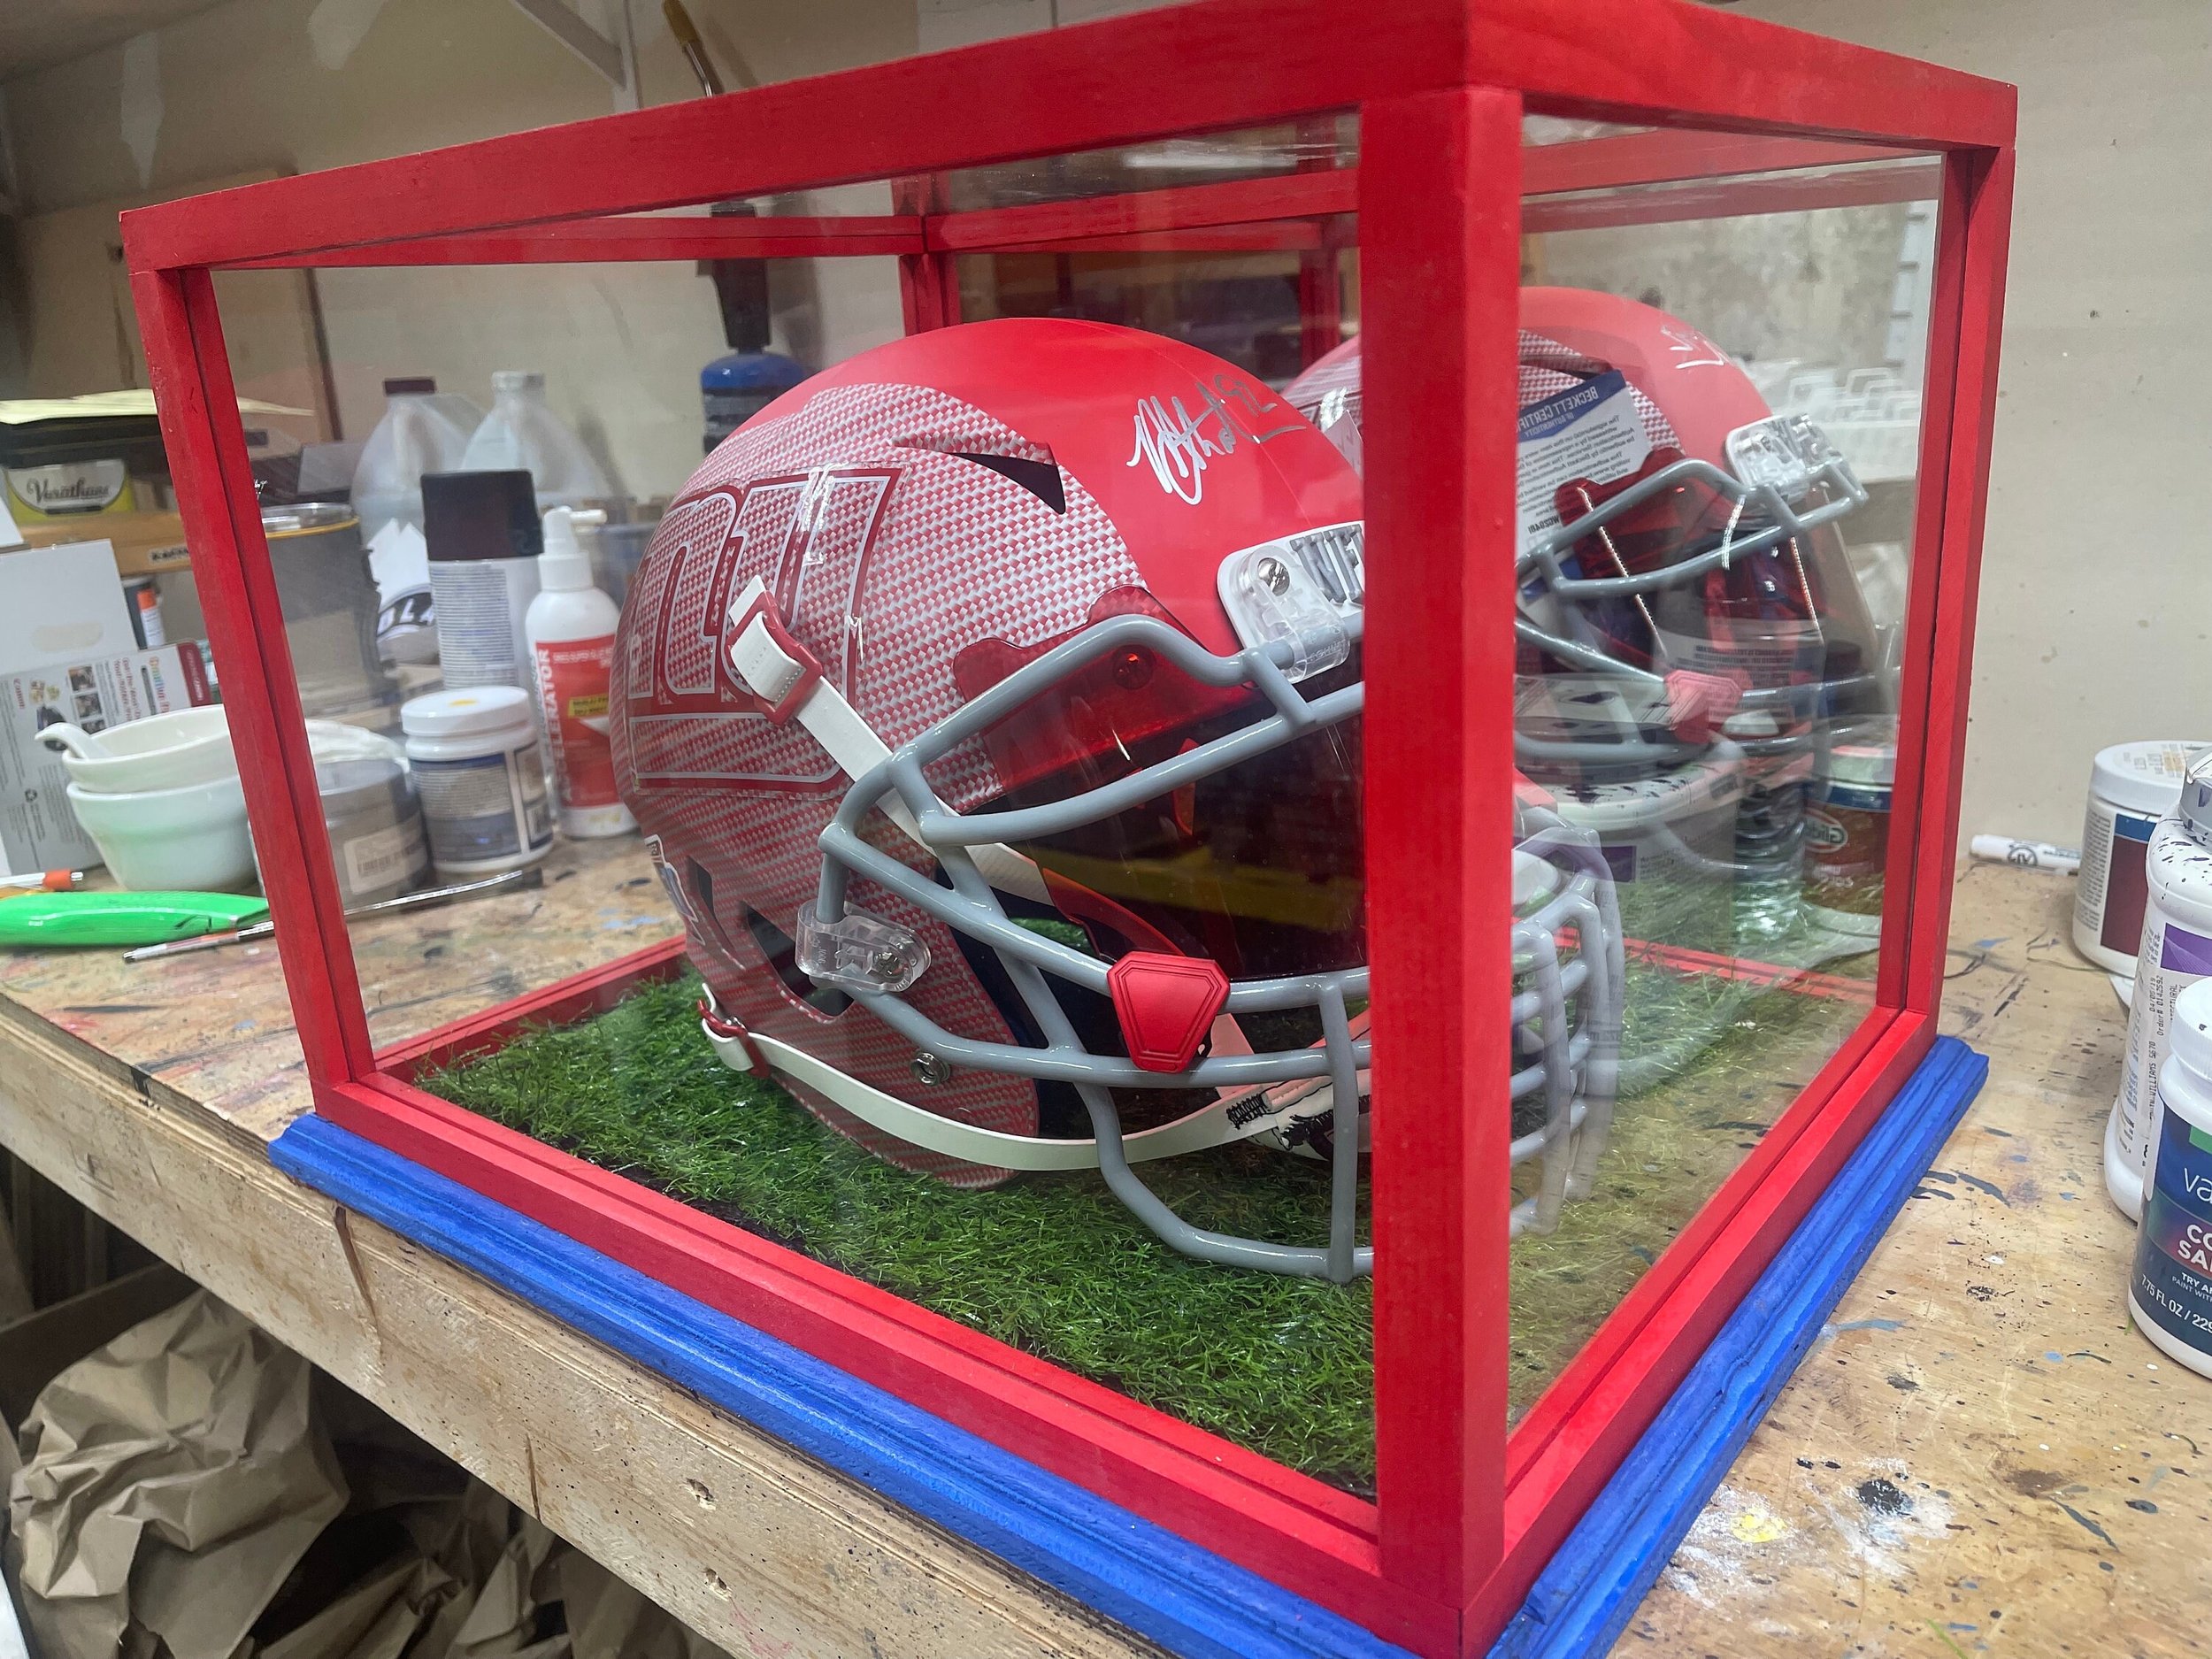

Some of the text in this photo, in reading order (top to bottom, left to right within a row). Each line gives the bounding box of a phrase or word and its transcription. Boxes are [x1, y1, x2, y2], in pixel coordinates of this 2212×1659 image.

[2172, 1275, 2193, 1293] PAINT
[2181, 1271, 2200, 1287] TRY
[2142, 1273, 2156, 1297] 7.75
[2155, 1288, 2167, 1308] FL
[2169, 1299, 2183, 1318] OZ
